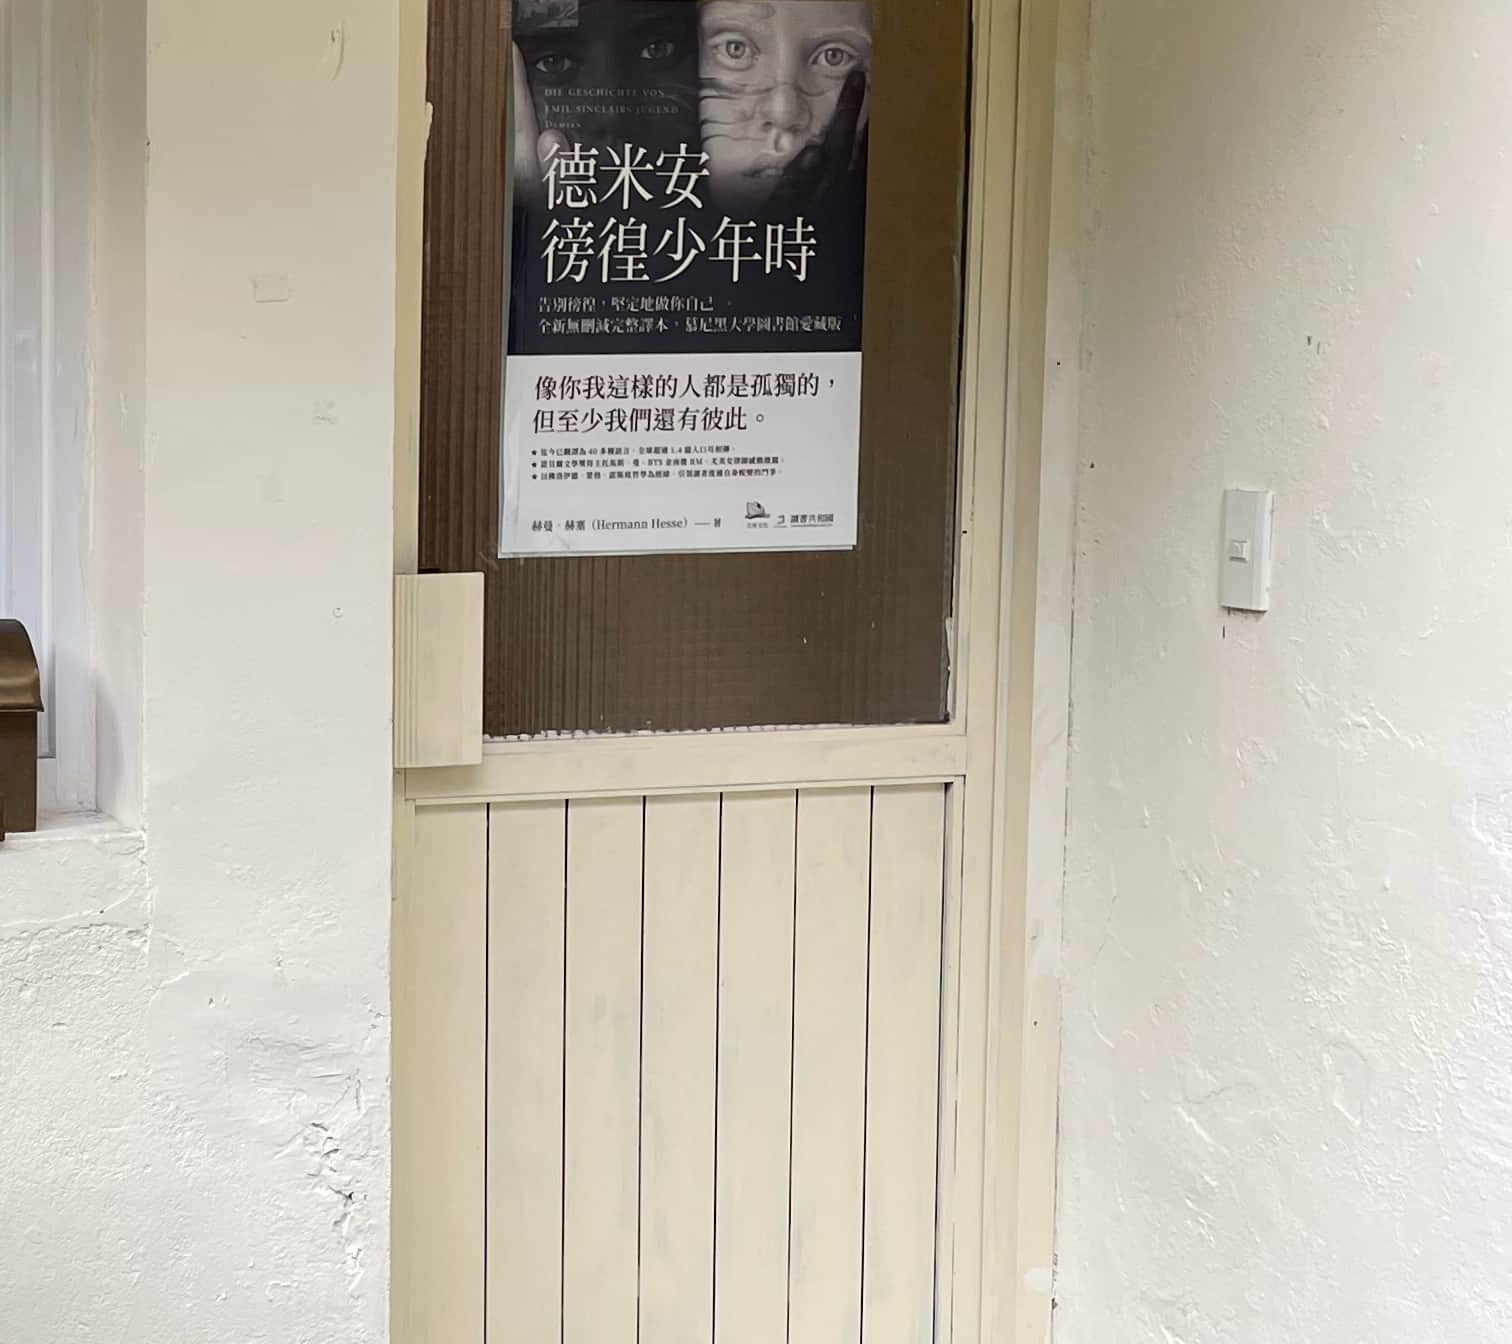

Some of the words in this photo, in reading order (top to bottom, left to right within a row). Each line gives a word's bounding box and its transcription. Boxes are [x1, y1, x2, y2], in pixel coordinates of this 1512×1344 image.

[542, 143, 711, 210] 德米安
[541, 216, 817, 284] 徬徨少年時
